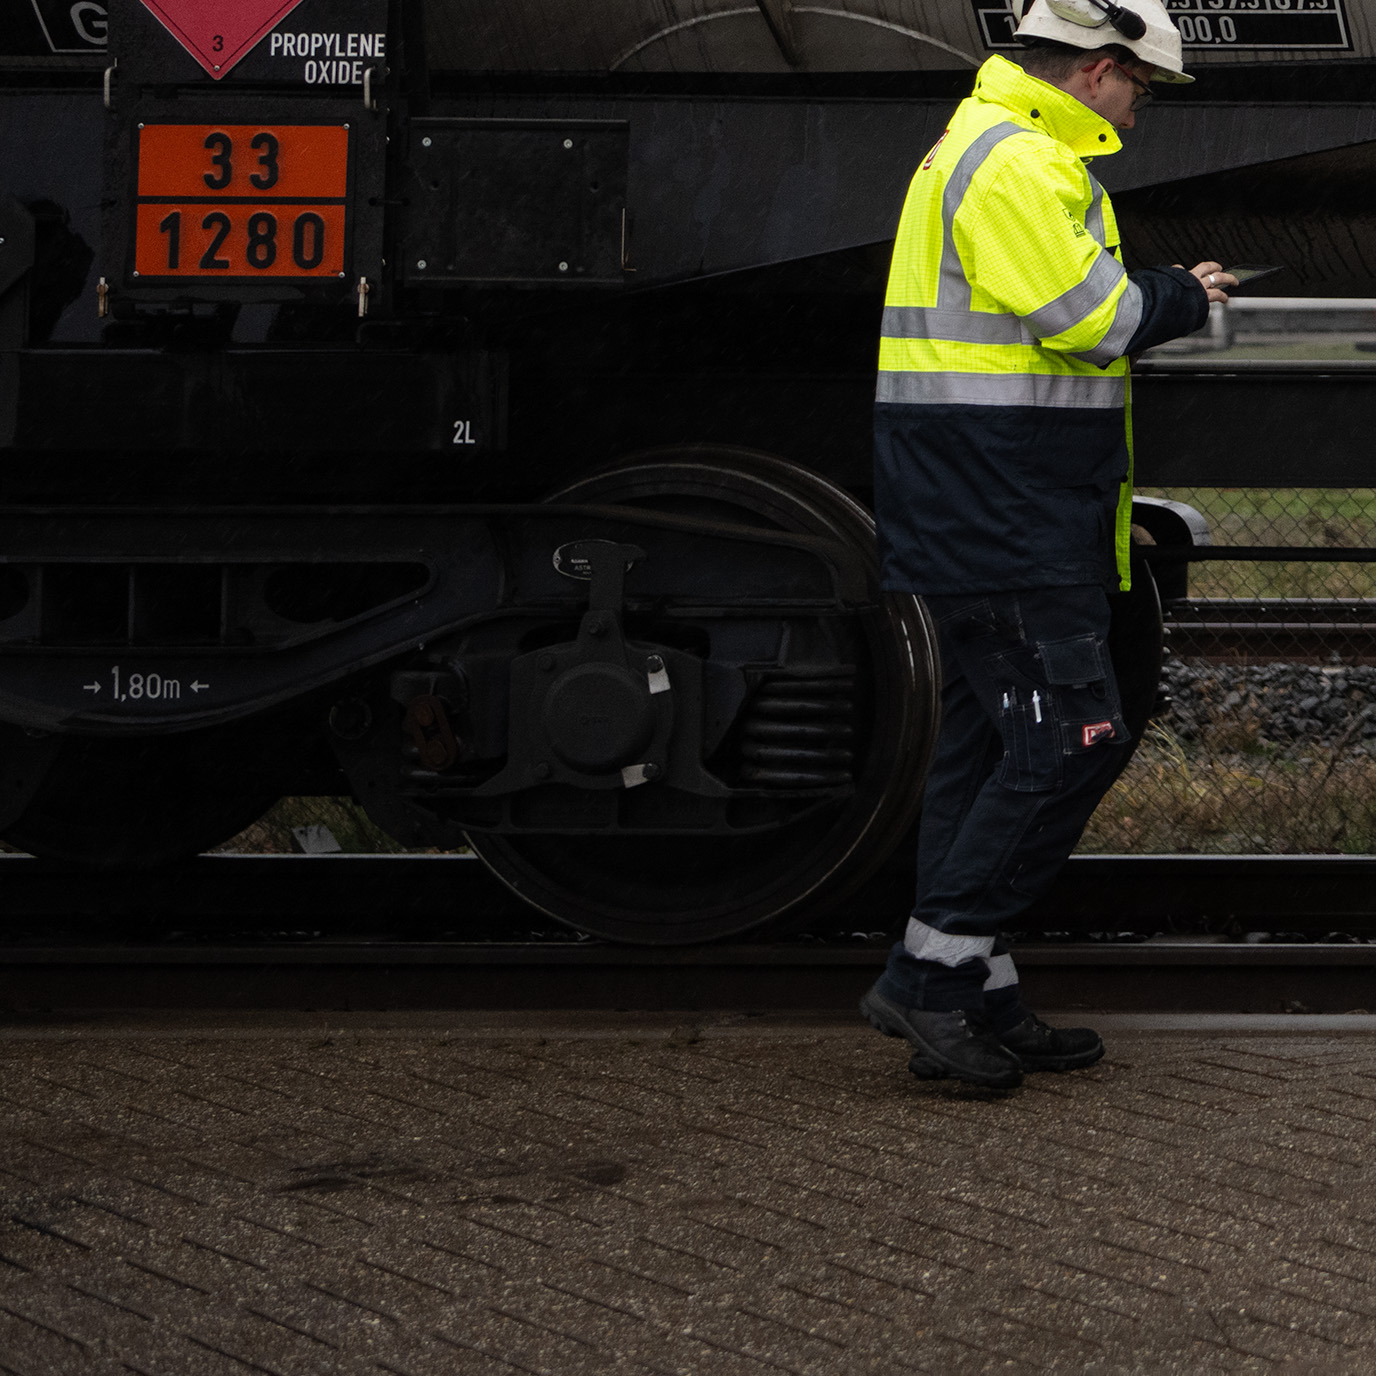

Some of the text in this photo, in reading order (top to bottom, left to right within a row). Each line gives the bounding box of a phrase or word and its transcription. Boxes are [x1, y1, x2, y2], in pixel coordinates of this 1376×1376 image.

[212, 34, 224, 53] 3
[270, 32, 386, 57] PROPYLENE
[304, 60, 363, 85] OXIDE
[159, 211, 326, 271] 1280
[453, 420, 476, 444] 2L
